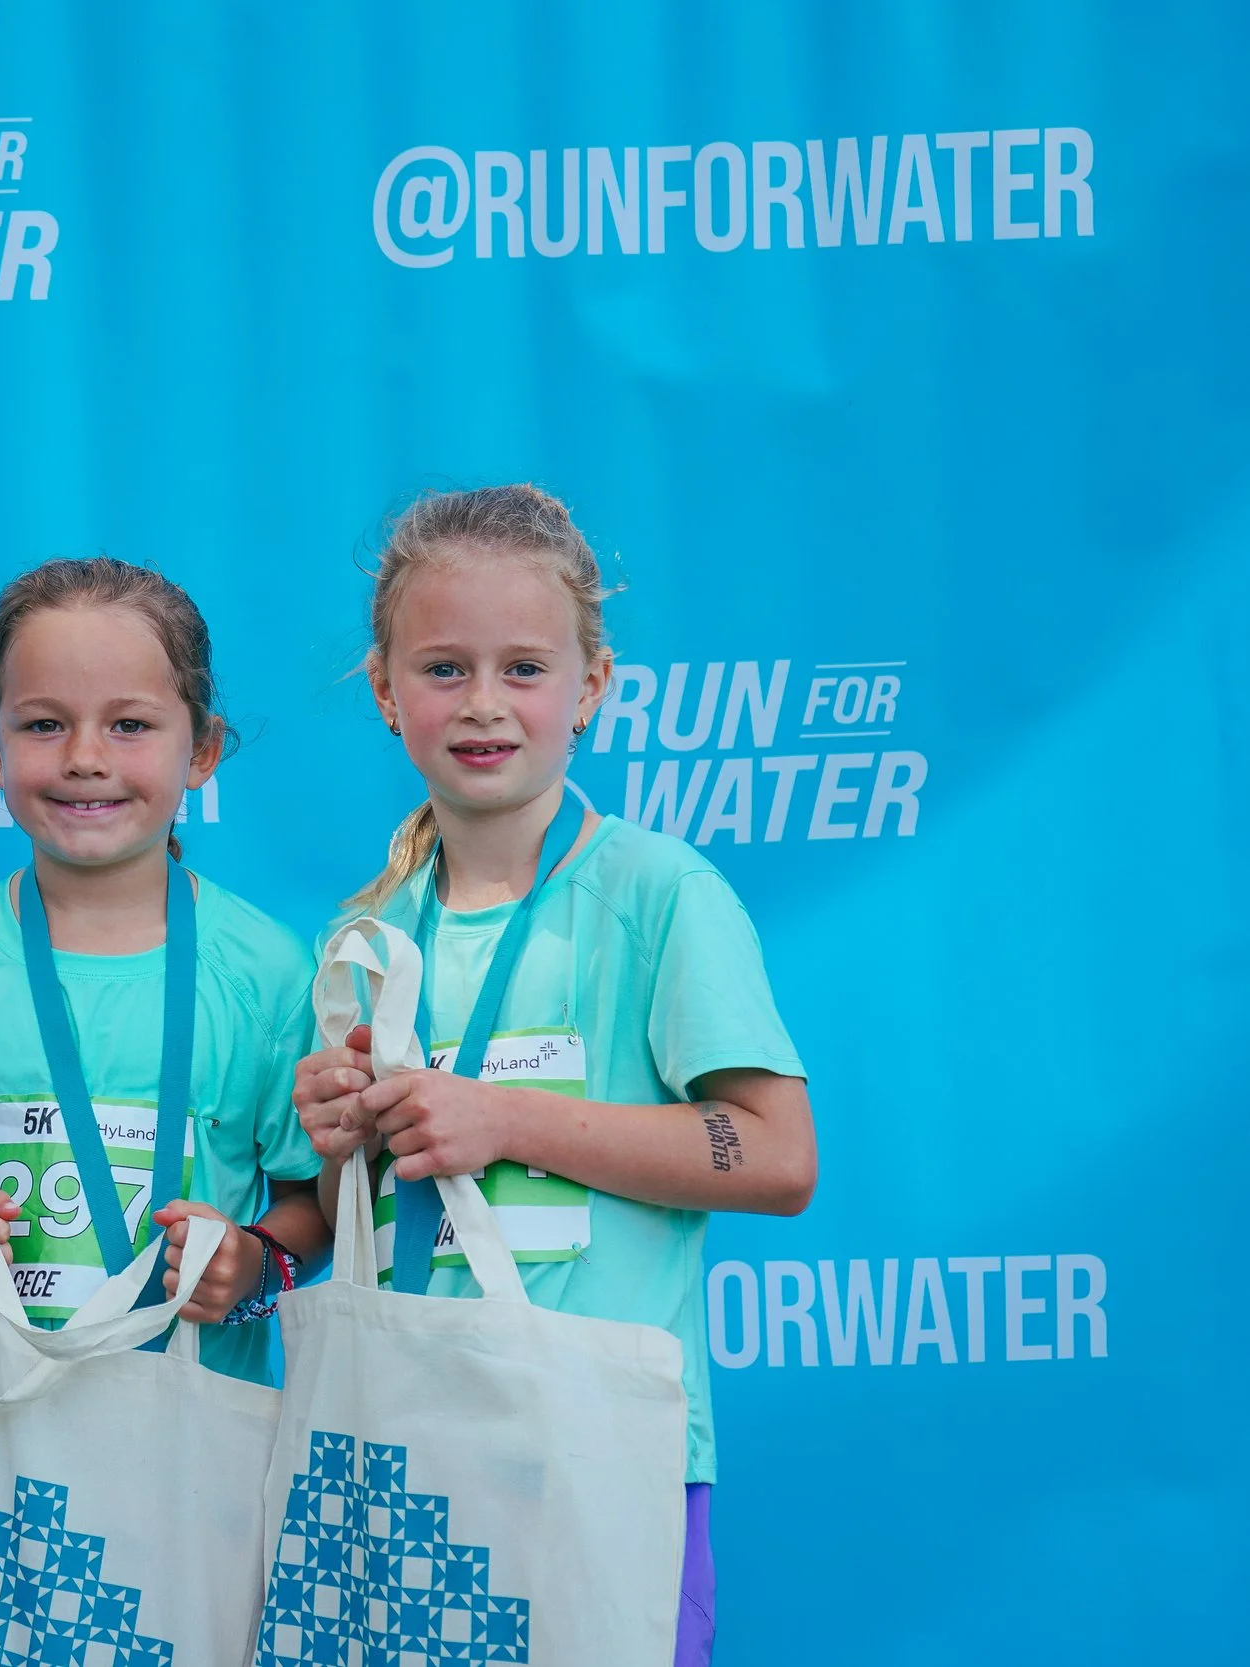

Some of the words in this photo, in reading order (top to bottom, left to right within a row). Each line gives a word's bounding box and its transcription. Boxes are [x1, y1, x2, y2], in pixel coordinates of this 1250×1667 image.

[373, 127, 1096, 268] @RUNFORWATER
[592, 659, 791, 753] RUN
[802, 676, 901, 726] FOR
[623, 751, 929, 846] WATER
[480, 1055, 540, 1074] HyLand
[23, 1107, 61, 1135] 5K
[97, 1123, 156, 1141] HyLand
[703, 1118, 731, 1172] WATER
[715, 1113, 741, 1147] RUN
[707, 1254, 1109, 1369] ORWATER
